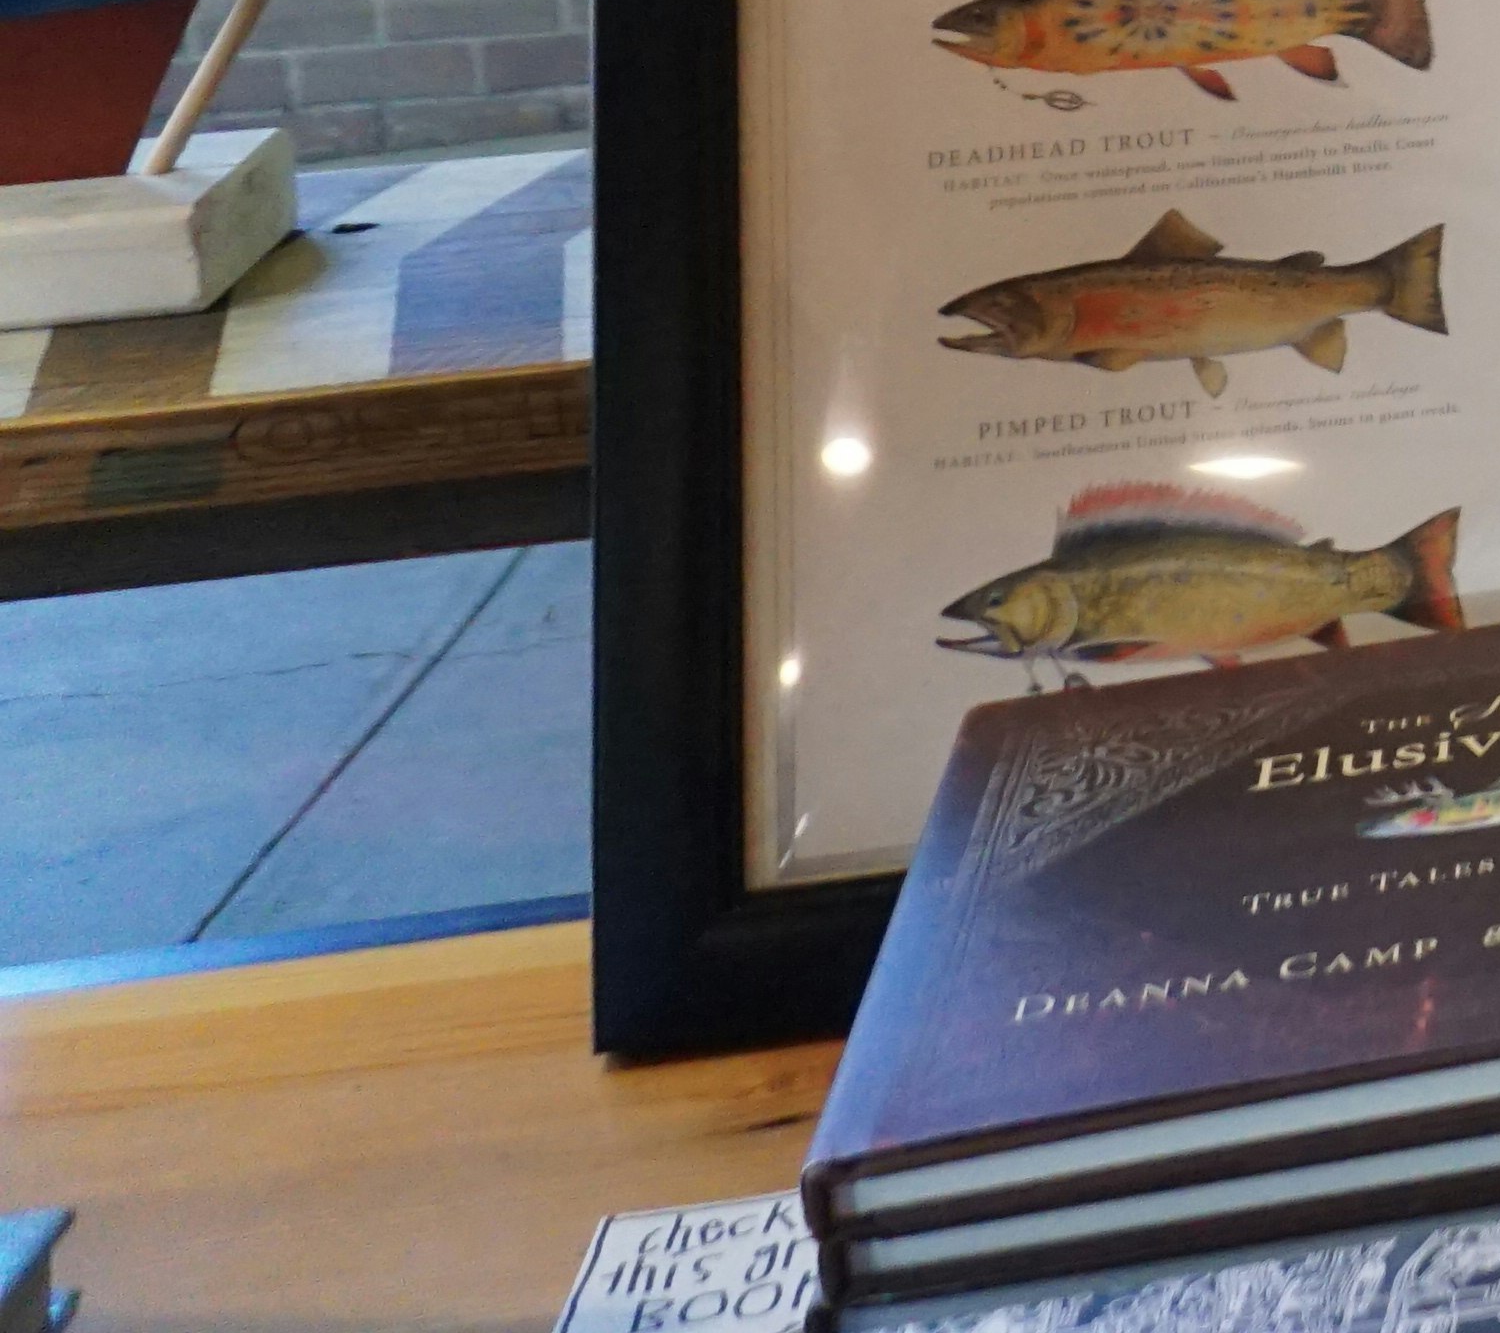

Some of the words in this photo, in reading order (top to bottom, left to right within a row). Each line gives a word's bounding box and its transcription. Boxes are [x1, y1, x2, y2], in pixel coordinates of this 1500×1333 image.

[926, 136, 1088, 170] DEADHEAD
[1101, 128, 1195, 154] TROUT
[977, 413, 1088, 440] PIMPED
[1099, 399, 1198, 428] TROUT
[1360, 712, 1431, 735] THE
[1370, 856, 1496, 894] TALES
[1013, 968, 1249, 1025] DEANNA
[1279, 936, 1439, 981] CAMP
[601, 1253, 722, 1296] this
